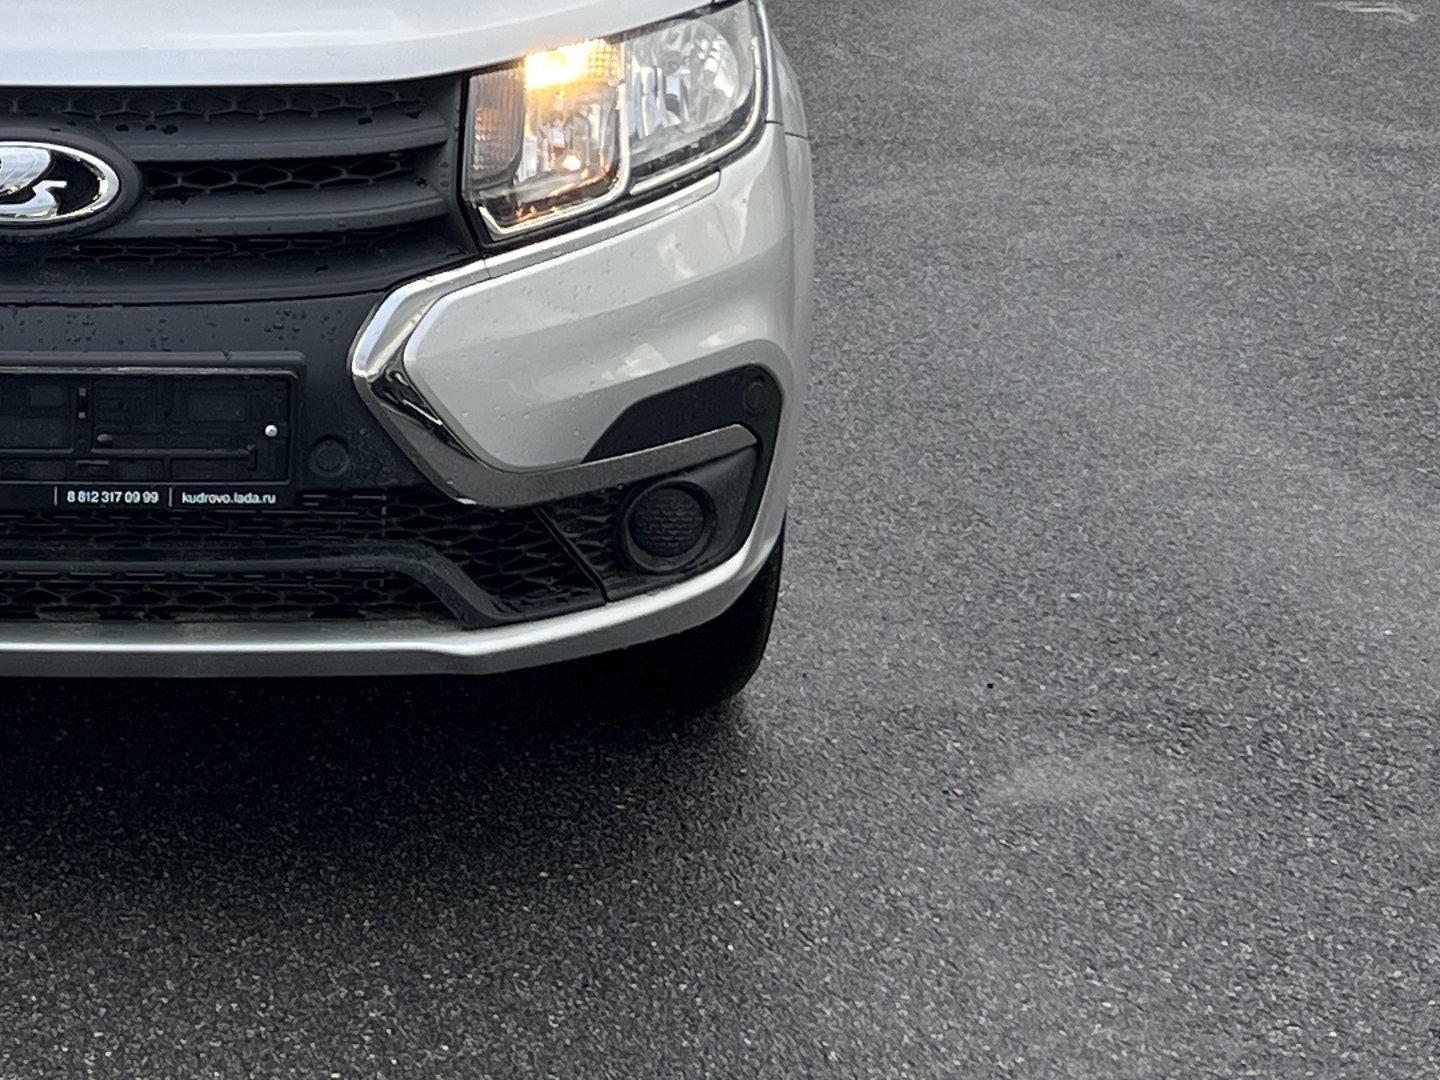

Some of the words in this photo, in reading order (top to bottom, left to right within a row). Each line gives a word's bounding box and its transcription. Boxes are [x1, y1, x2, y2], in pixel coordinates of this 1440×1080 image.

[67, 490, 76, 503] 8
[78, 490, 99, 503] 812
[101, 490, 122, 503] 317
[142, 491, 159, 504] 99
[182, 491, 276, 504] kudrovo.lada.ru
